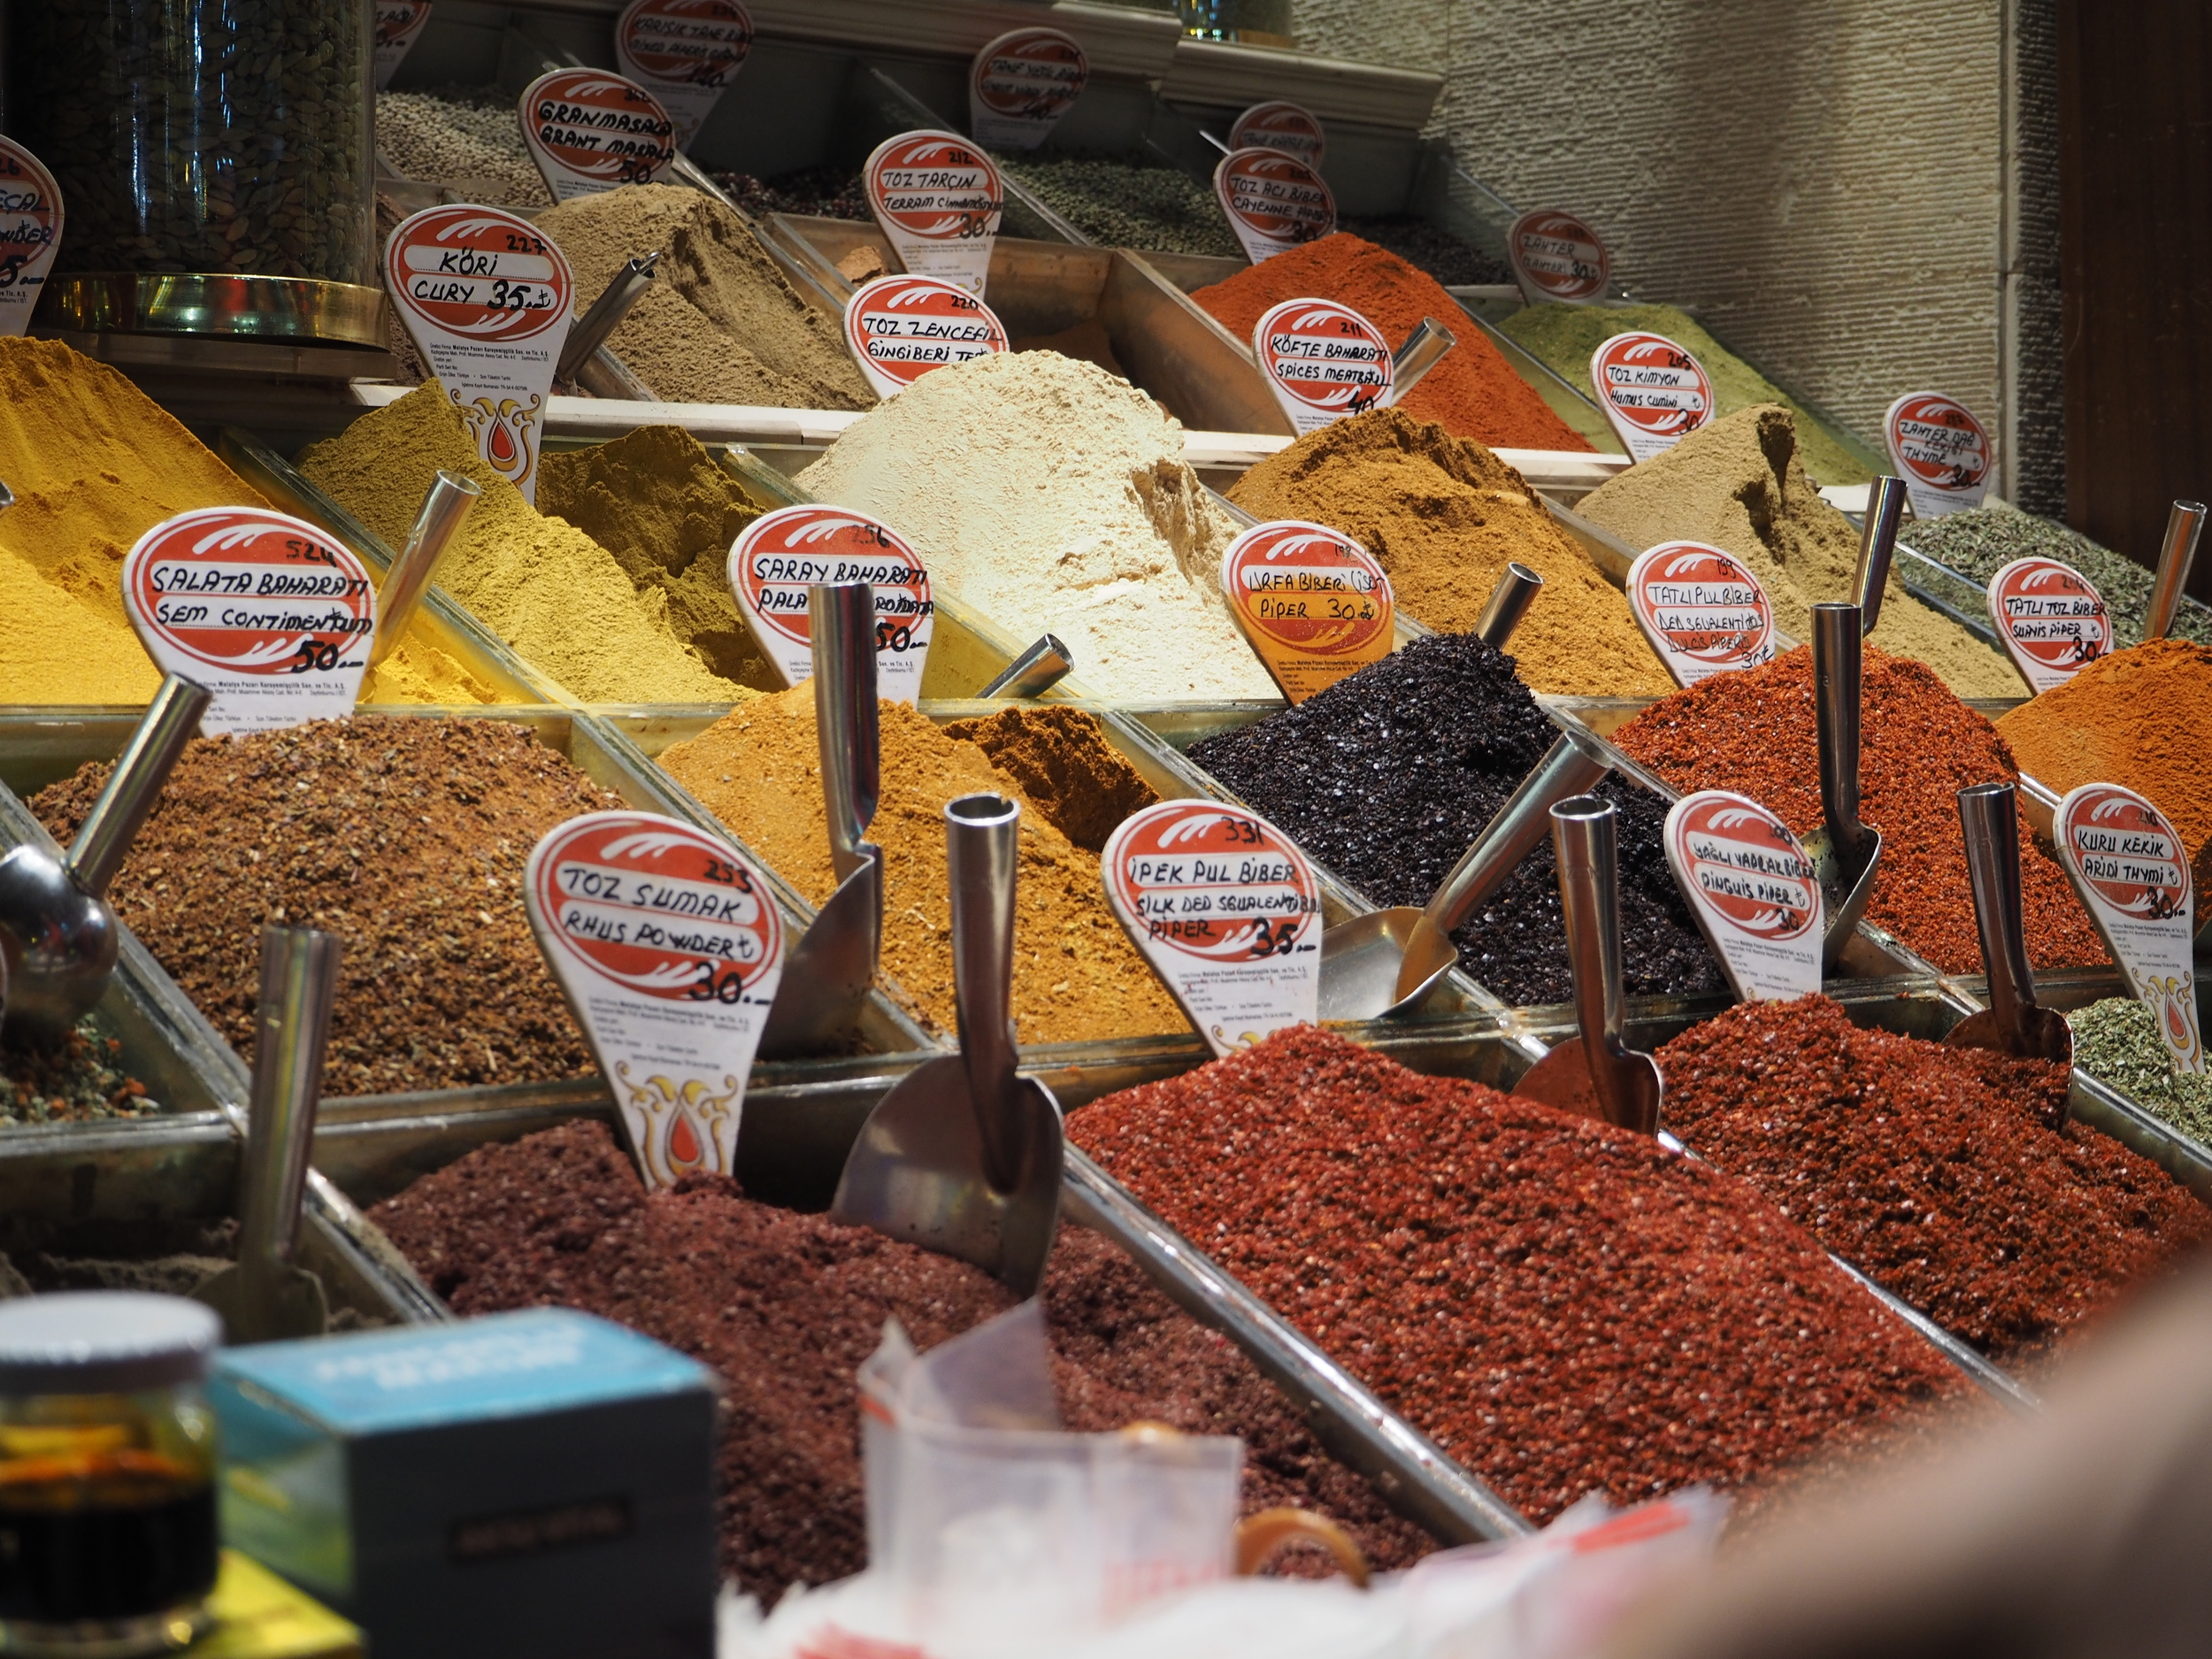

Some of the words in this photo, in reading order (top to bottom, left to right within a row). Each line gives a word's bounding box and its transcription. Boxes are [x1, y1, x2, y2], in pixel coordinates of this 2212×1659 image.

[883, 173, 912, 187] TOZ
[918, 173, 976, 190] TARÇIN
[1231, 178, 1256, 193] TOZ
[1263, 183, 1286, 196] ACI
[884, 196, 933, 210] TERRAM
[1232, 196, 1292, 217] CAYENNE
[506, 234, 547, 256] 227
[439, 247, 498, 276] KÖRİ
[414, 280, 475, 303] CURY
[863, 318, 901, 334] TOZ
[908, 322, 1002, 342] ZENCEFİL
[1271, 334, 1321, 357] KÖFTE
[1325, 343, 1387, 362] BAHARATI
[1609, 366, 1631, 381] TOZ
[1635, 366, 1679, 385] KİMYON
[1903, 446, 1946, 465] THYME
[286, 541, 337, 567] 524
[152, 567, 252, 593] SALATA
[257, 573, 368, 596] BAHARATI
[755, 558, 829, 581] SARAY
[833, 563, 927, 586] BAHARATI
[1249, 572, 1294, 592] URFA
[758, 588, 810, 612] PALA
[1648, 587, 1692, 605] TATLI
[1695, 587, 1721, 604] PUL
[2006, 598, 2043, 615] TATLI
[2047, 602, 2070, 615] TOZ
[2073, 597, 2108, 616] BİBER
[157, 603, 208, 625] SEM
[1221, 817, 1264, 845] 331
[2078, 830, 2116, 852] KURU
[2122, 834, 2163, 857] KEKİK
[1130, 858, 1183, 883] İPEK
[1194, 860, 1231, 883] PUL
[1239, 857, 1299, 884] BİBER
[565, 868, 622, 899] TOZ
[632, 884, 741, 922] SUMAK
[1181, 895, 1211, 912] DED
[1776, 908, 1800, 931] 30
[565, 910, 625, 943] RHUS
[634, 924, 734, 960] POWDER
